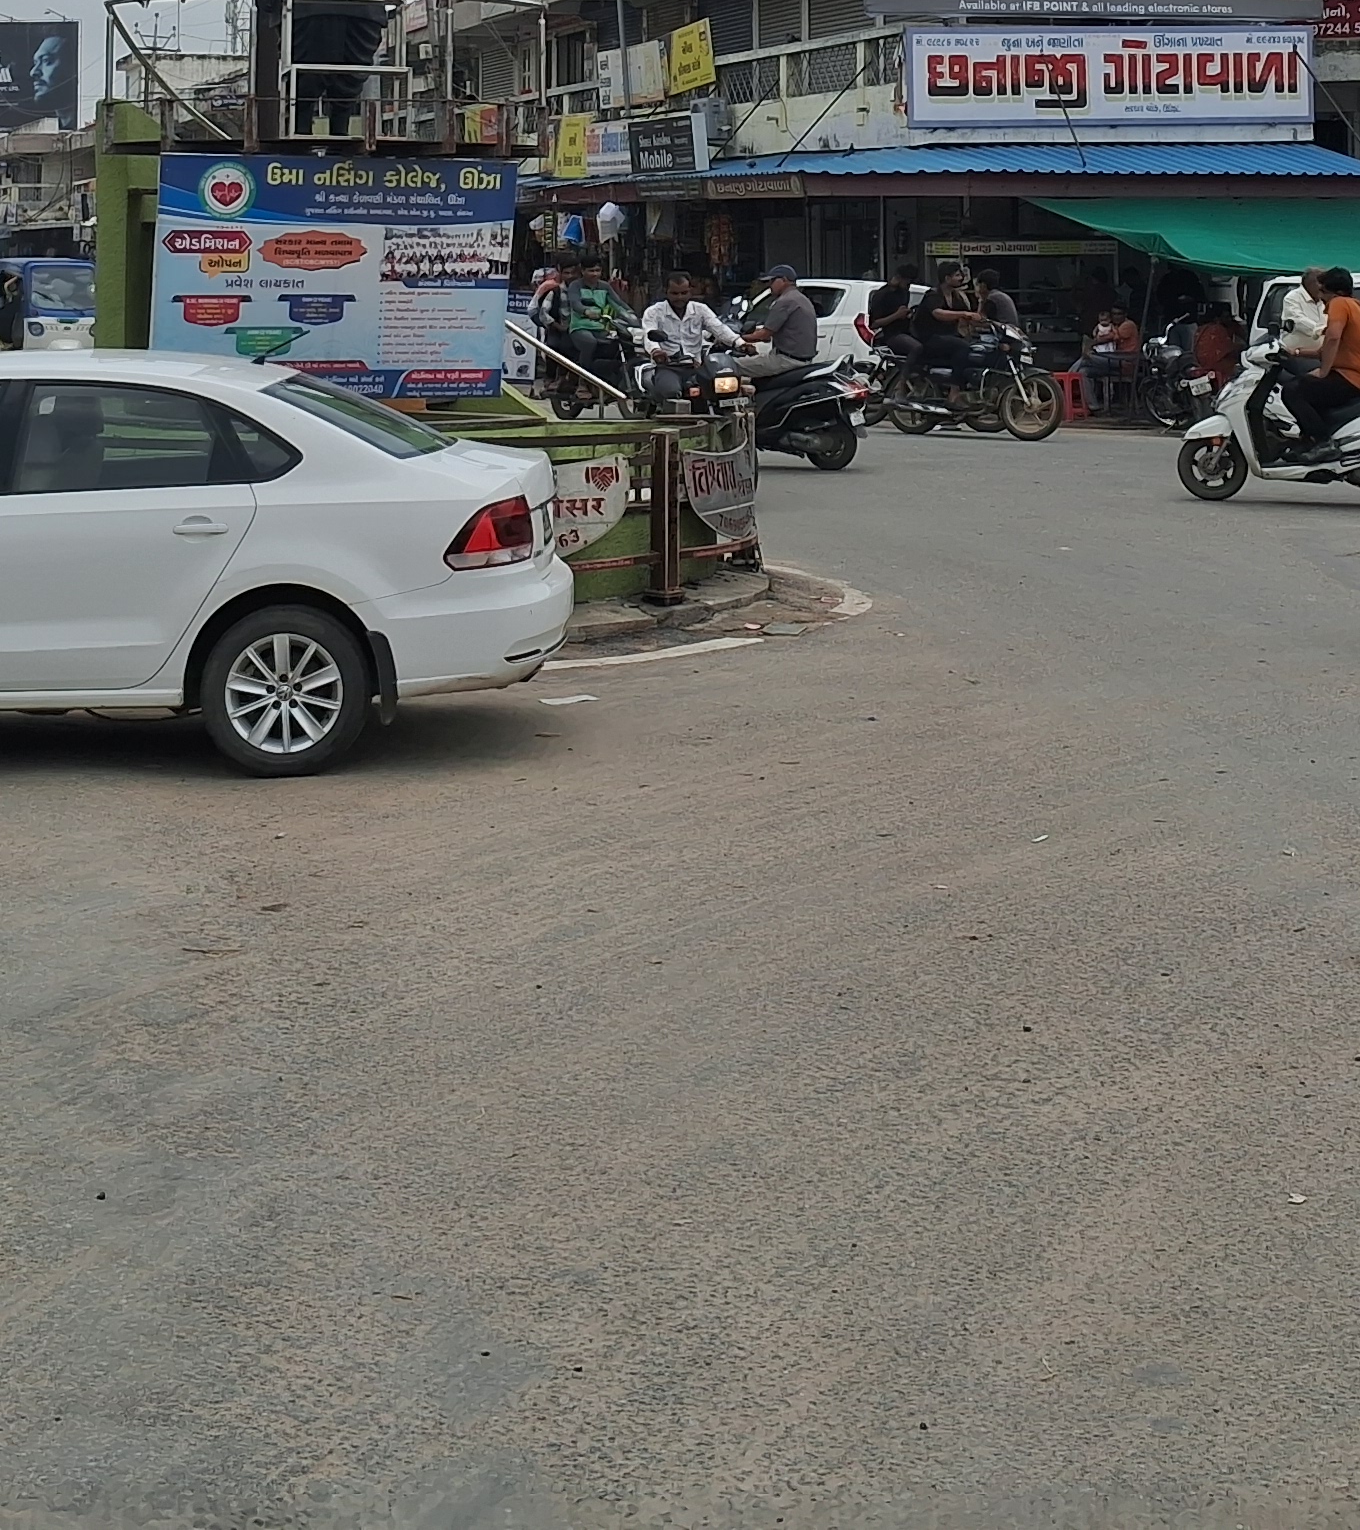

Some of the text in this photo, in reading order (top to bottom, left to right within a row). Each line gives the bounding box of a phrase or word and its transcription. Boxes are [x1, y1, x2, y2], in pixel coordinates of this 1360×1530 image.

[959, 0, 1232, 15] Available at IFB POINT & all leading electronic stores
[928, 39, 1298, 108] છનાજી ગોટાવાળા
[640, 149, 674, 170] Mobile
[266, 159, 502, 193] ઉમા નર્સિંગ કોલેજ, ઊંઝા
[716, 176, 790, 202] છનાજી ગોટાવાળા
[174, 234, 240, 250] એડમિશન
[208, 254, 242, 269] ઓપન
[225, 274, 305, 289] પ્રવેશ લાયકાત
